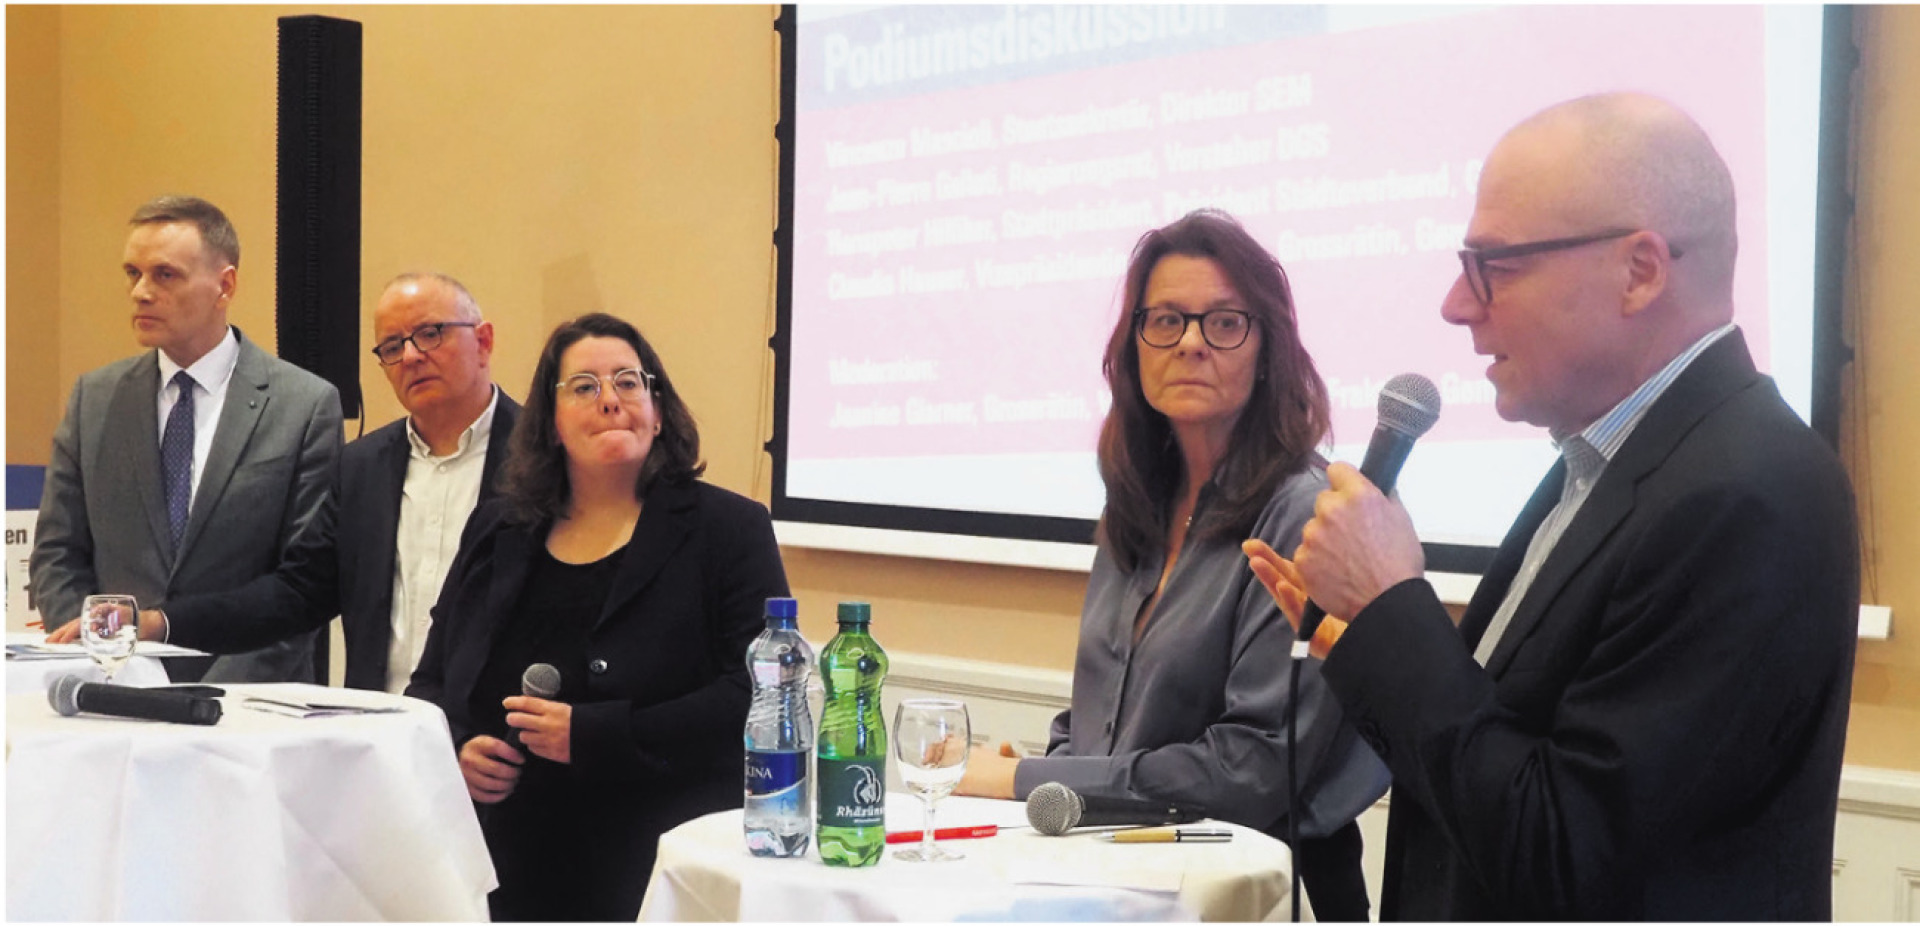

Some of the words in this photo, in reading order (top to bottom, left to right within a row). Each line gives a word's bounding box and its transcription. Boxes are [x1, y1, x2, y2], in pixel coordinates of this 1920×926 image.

[825, 5, 1227, 92] Podiumsdiskussion
[1161, 88, 1249, 123] Direktor
[1256, 72, 1312, 111] SEM
